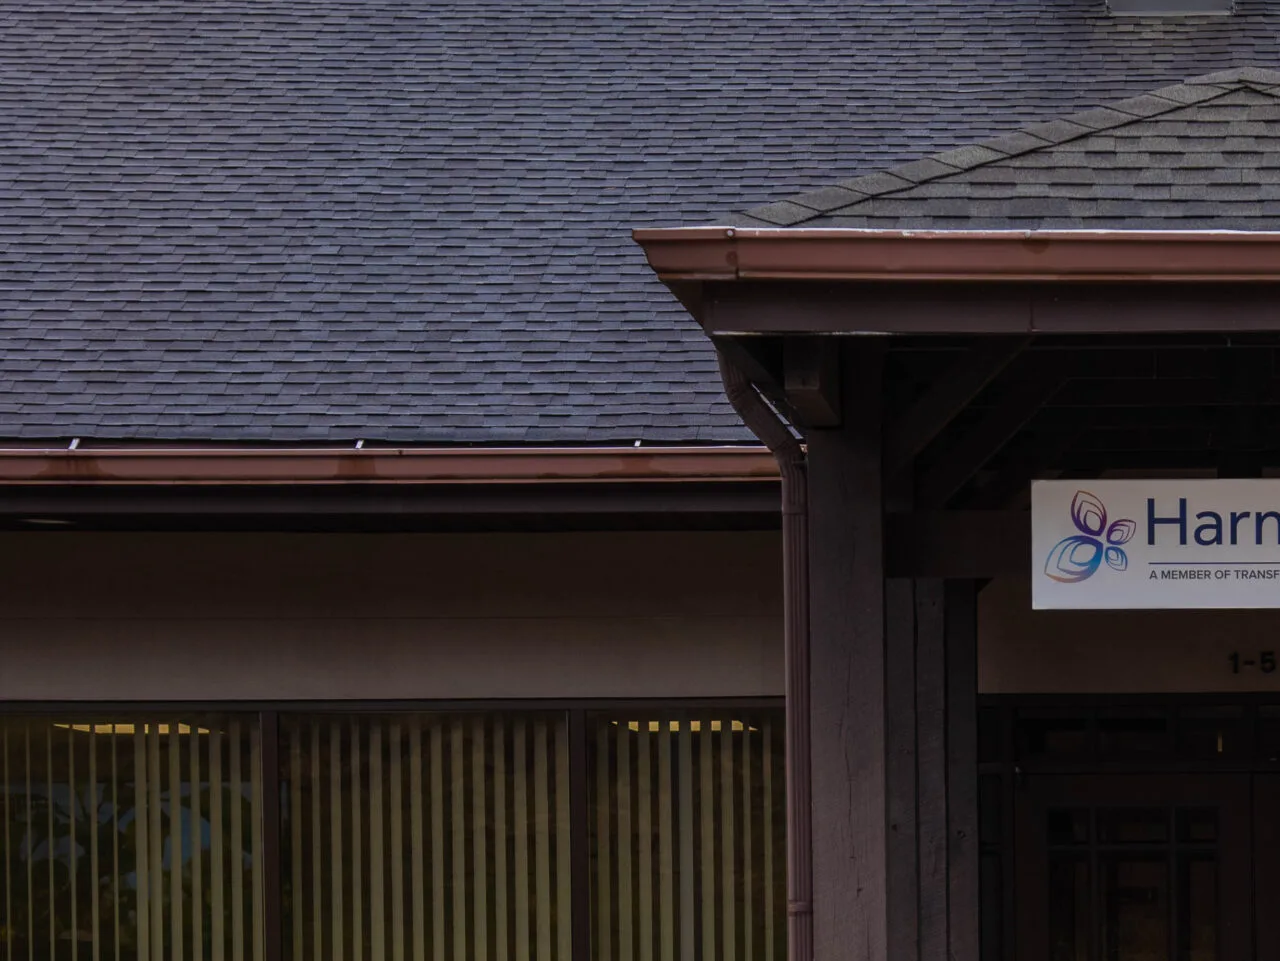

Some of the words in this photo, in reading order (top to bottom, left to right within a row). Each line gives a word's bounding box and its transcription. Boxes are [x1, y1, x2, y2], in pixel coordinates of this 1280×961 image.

[1148, 569, 1159, 580] A
[1161, 569, 1212, 580] MEMBER
[1214, 568, 1232, 580] OF
[1227, 650, 1277, 674] 1-5
